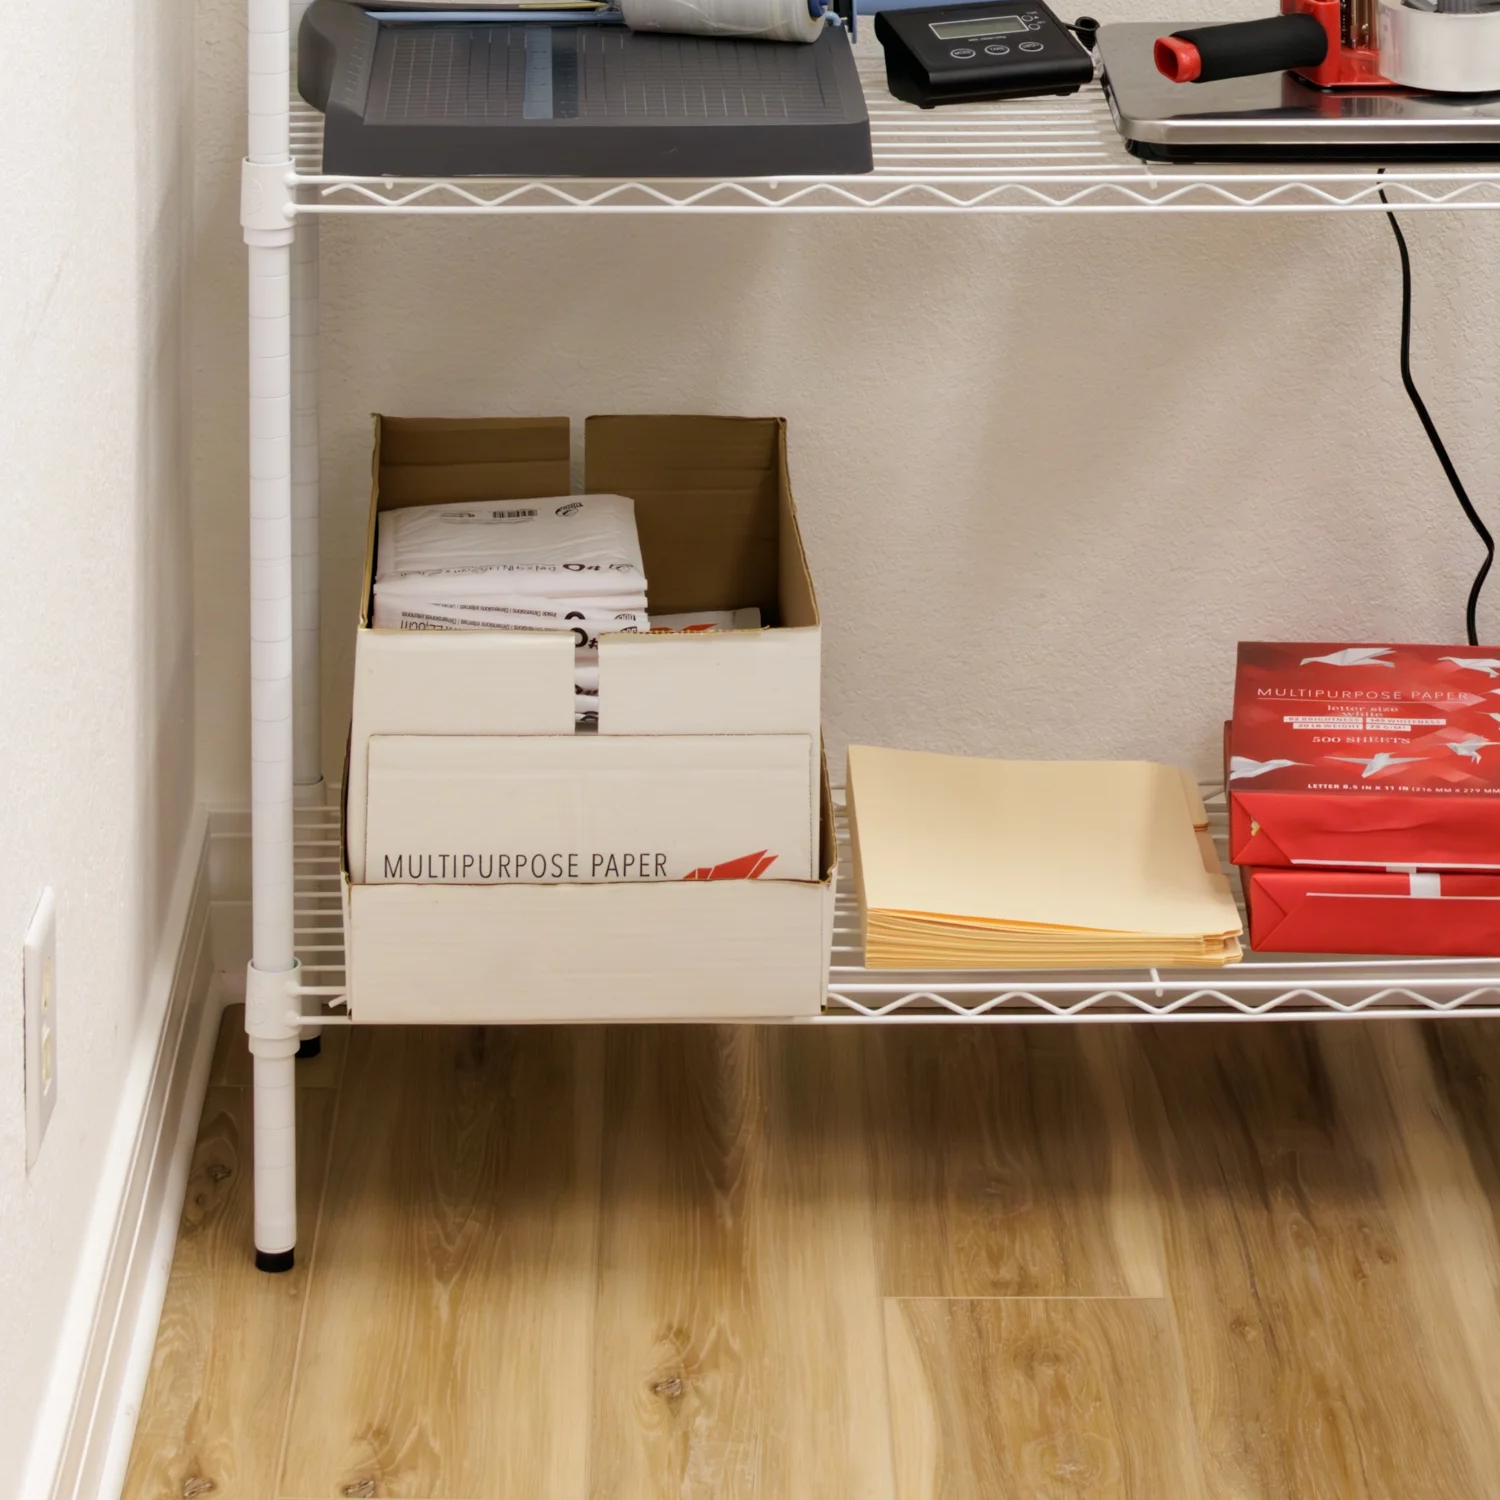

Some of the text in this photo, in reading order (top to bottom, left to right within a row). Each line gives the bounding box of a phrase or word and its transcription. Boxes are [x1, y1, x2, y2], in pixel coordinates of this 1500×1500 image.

[512, 608, 541, 617] Dimensions
[1257, 688, 1468, 701] MULTIPURPOSE PAPER
[1327, 704, 1366, 712] letter
[1346, 736, 1411, 744] SHEETS
[384, 853, 667, 879] MULTIPURPOSE PAPER
